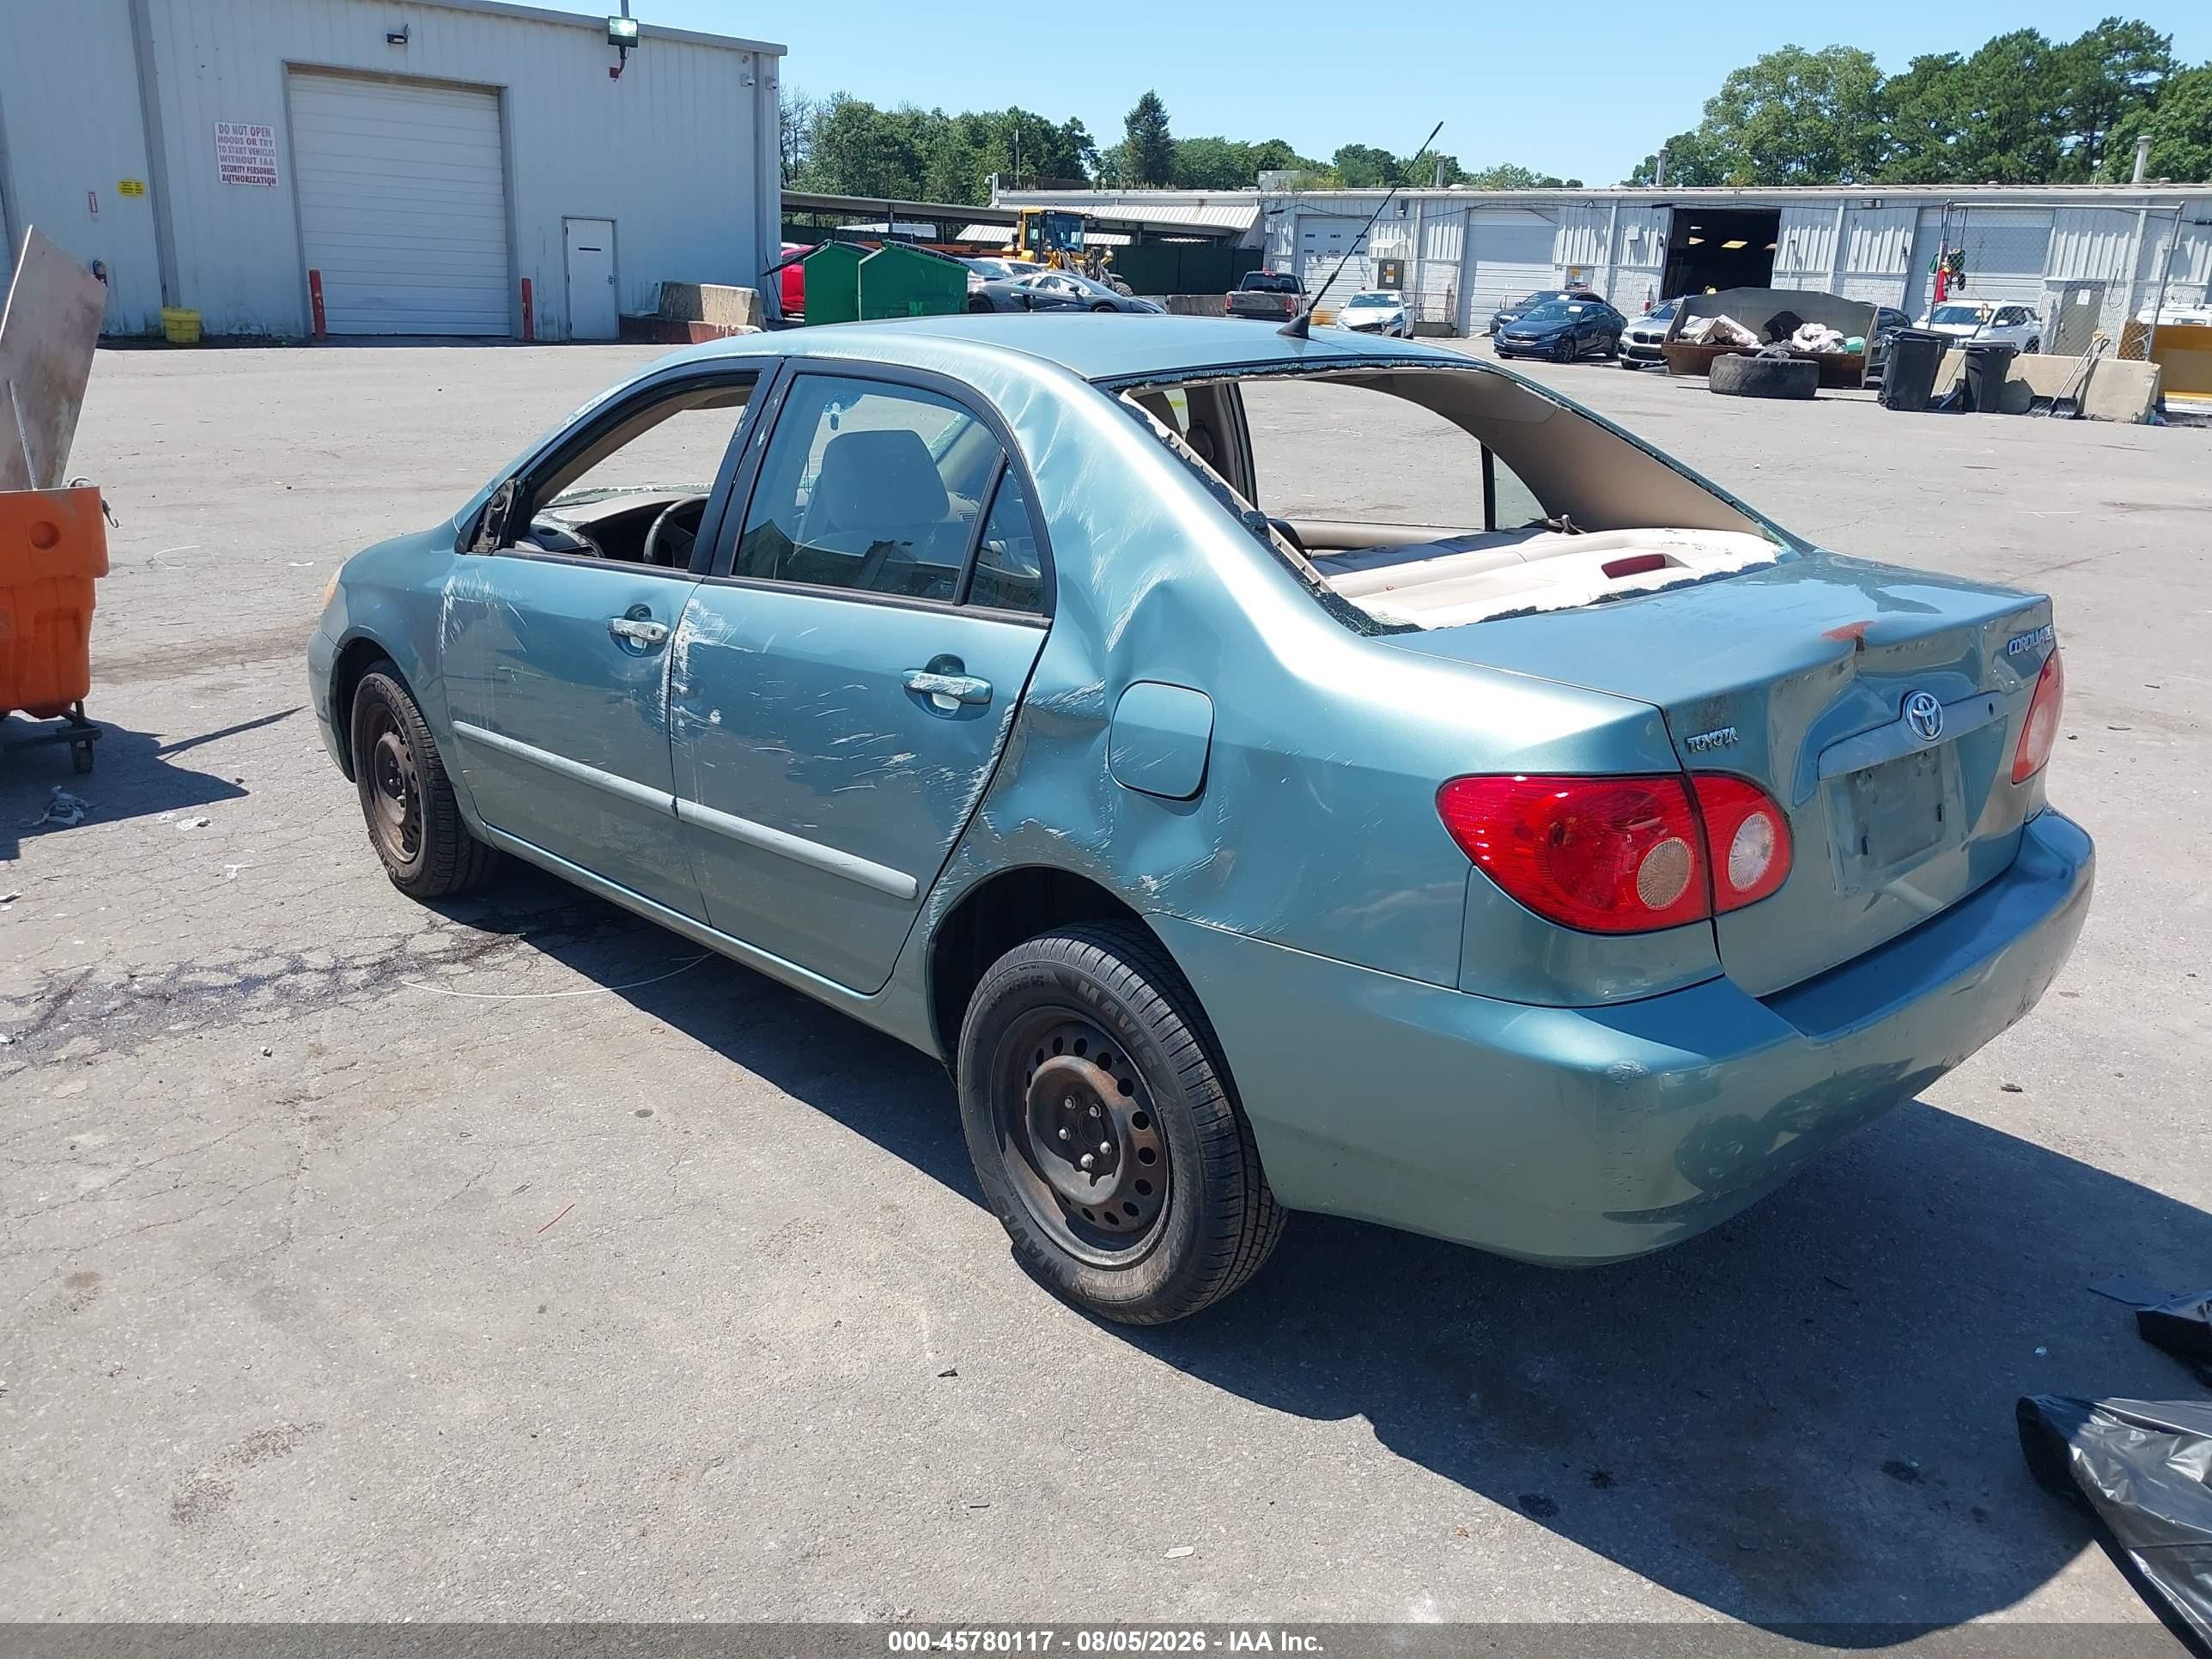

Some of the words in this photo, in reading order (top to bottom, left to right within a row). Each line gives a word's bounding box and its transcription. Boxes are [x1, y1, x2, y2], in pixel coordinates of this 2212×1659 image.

[218, 124, 230, 135] DO
[232, 125, 248, 137] NOT
[250, 126, 271, 137] OPEN
[217, 136, 244, 145] HOODS
[246, 137, 258, 146] OR
[218, 145, 227, 154] TO
[228, 146, 246, 155] START
[248, 148, 276, 157] VEHICLES
[219, 155, 258, 165] WITHOUT
[259, 157, 274, 166] IAA
[221, 164, 246, 173] SECURITY
[246, 166, 276, 176] PERSONNEL
[222, 173, 276, 185] AUTHORIZATION
[1686, 726, 1739, 753] TOYOTA
[1077, 980, 1160, 1069] MAVIS
